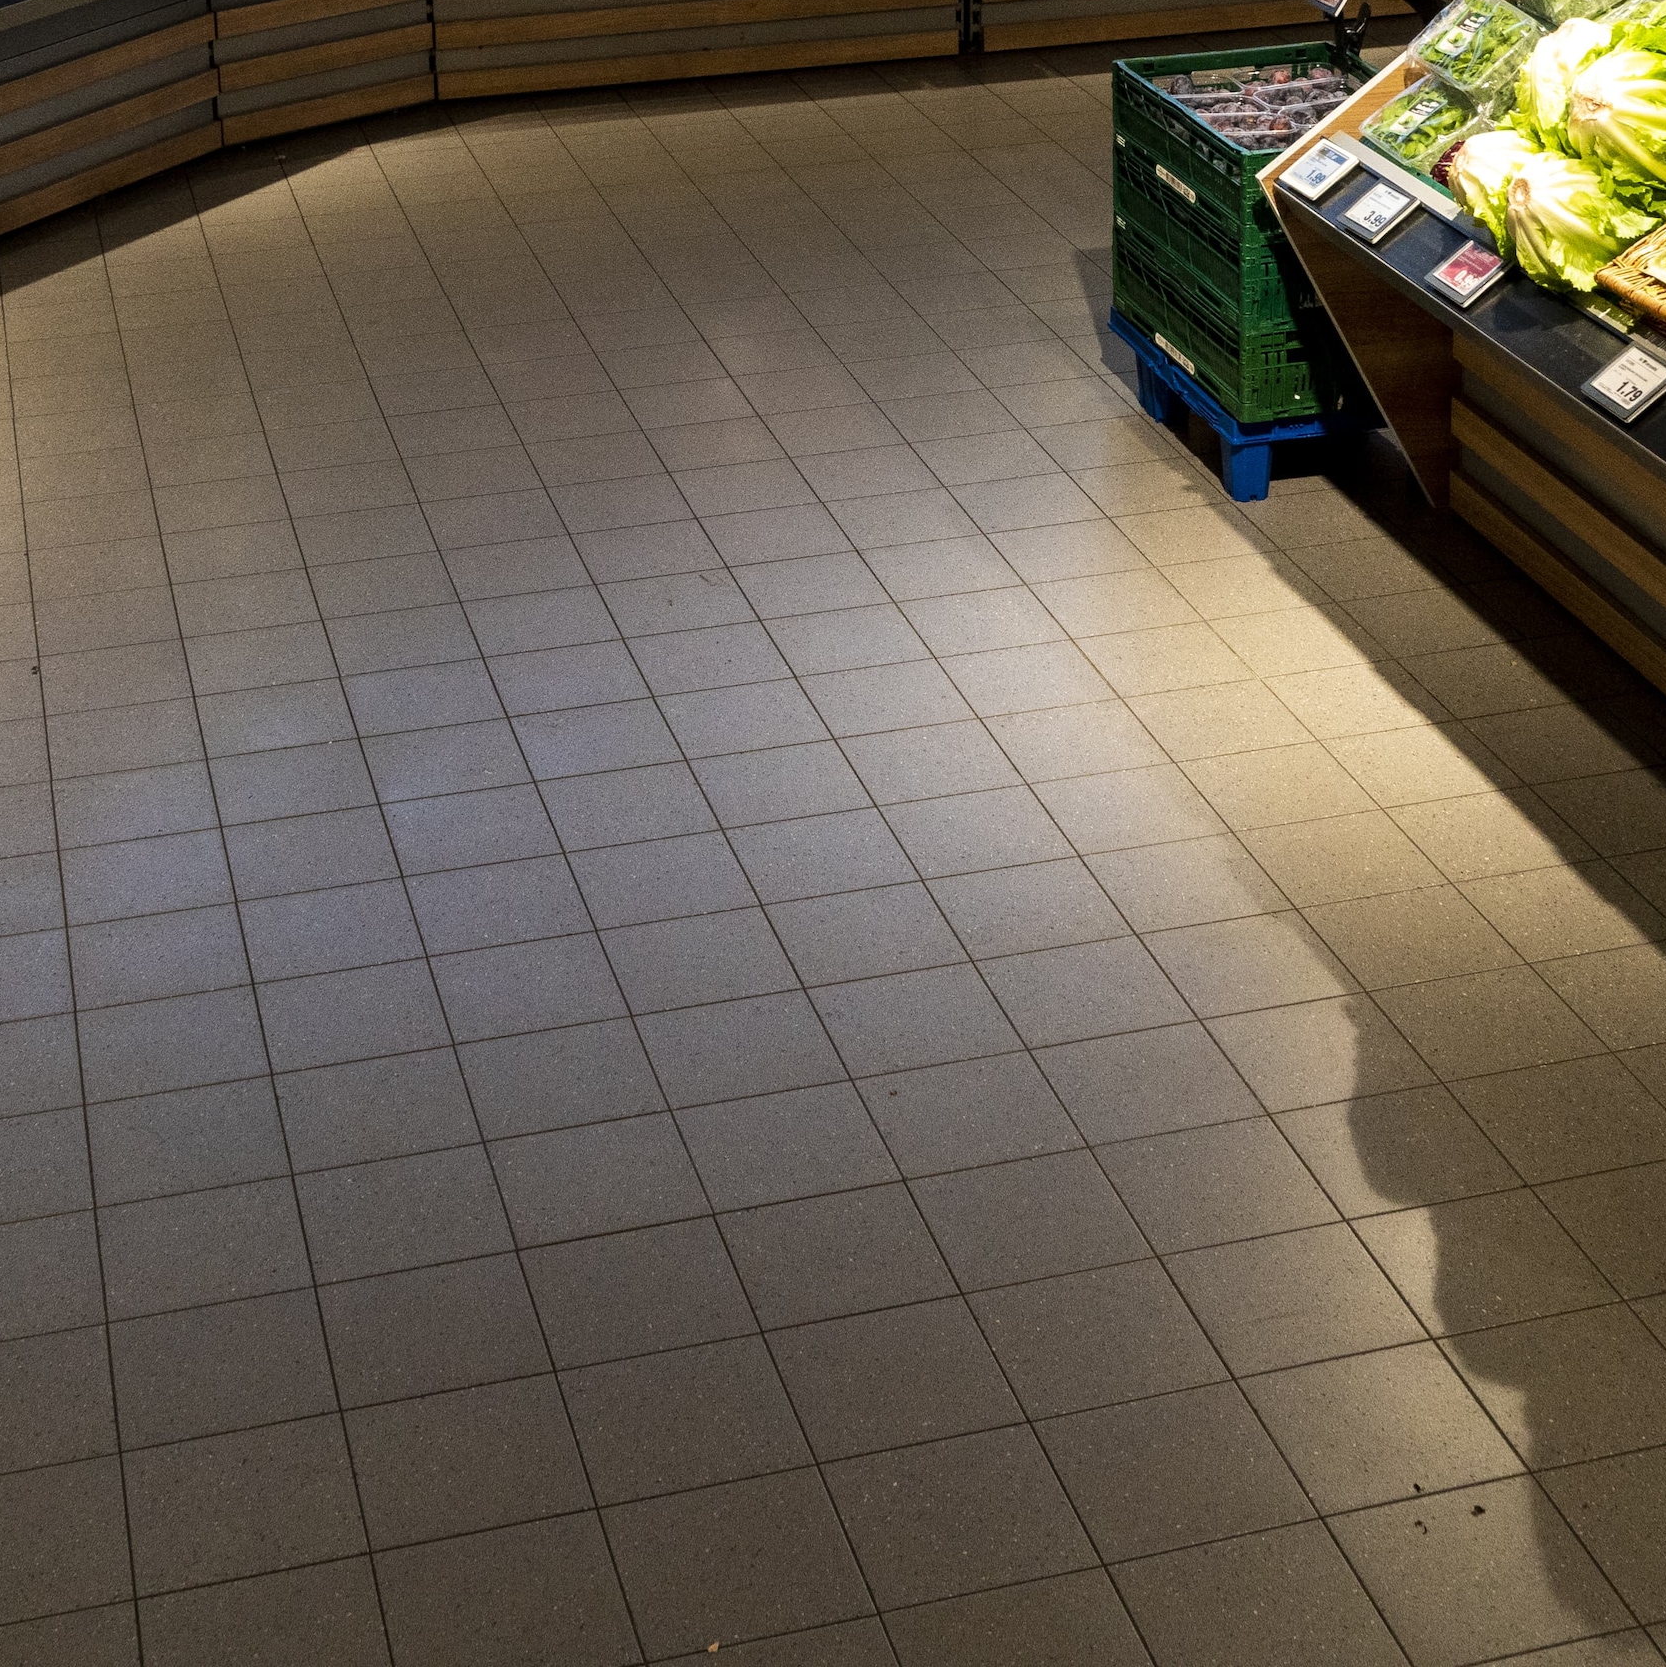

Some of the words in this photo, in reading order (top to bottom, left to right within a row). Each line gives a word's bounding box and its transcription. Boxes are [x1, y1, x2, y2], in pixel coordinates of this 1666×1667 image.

[1306, 169, 1326, 184] 1.99
[1361, 211, 1386, 227] 3.99
[1616, 381, 1643, 403] 1.79
